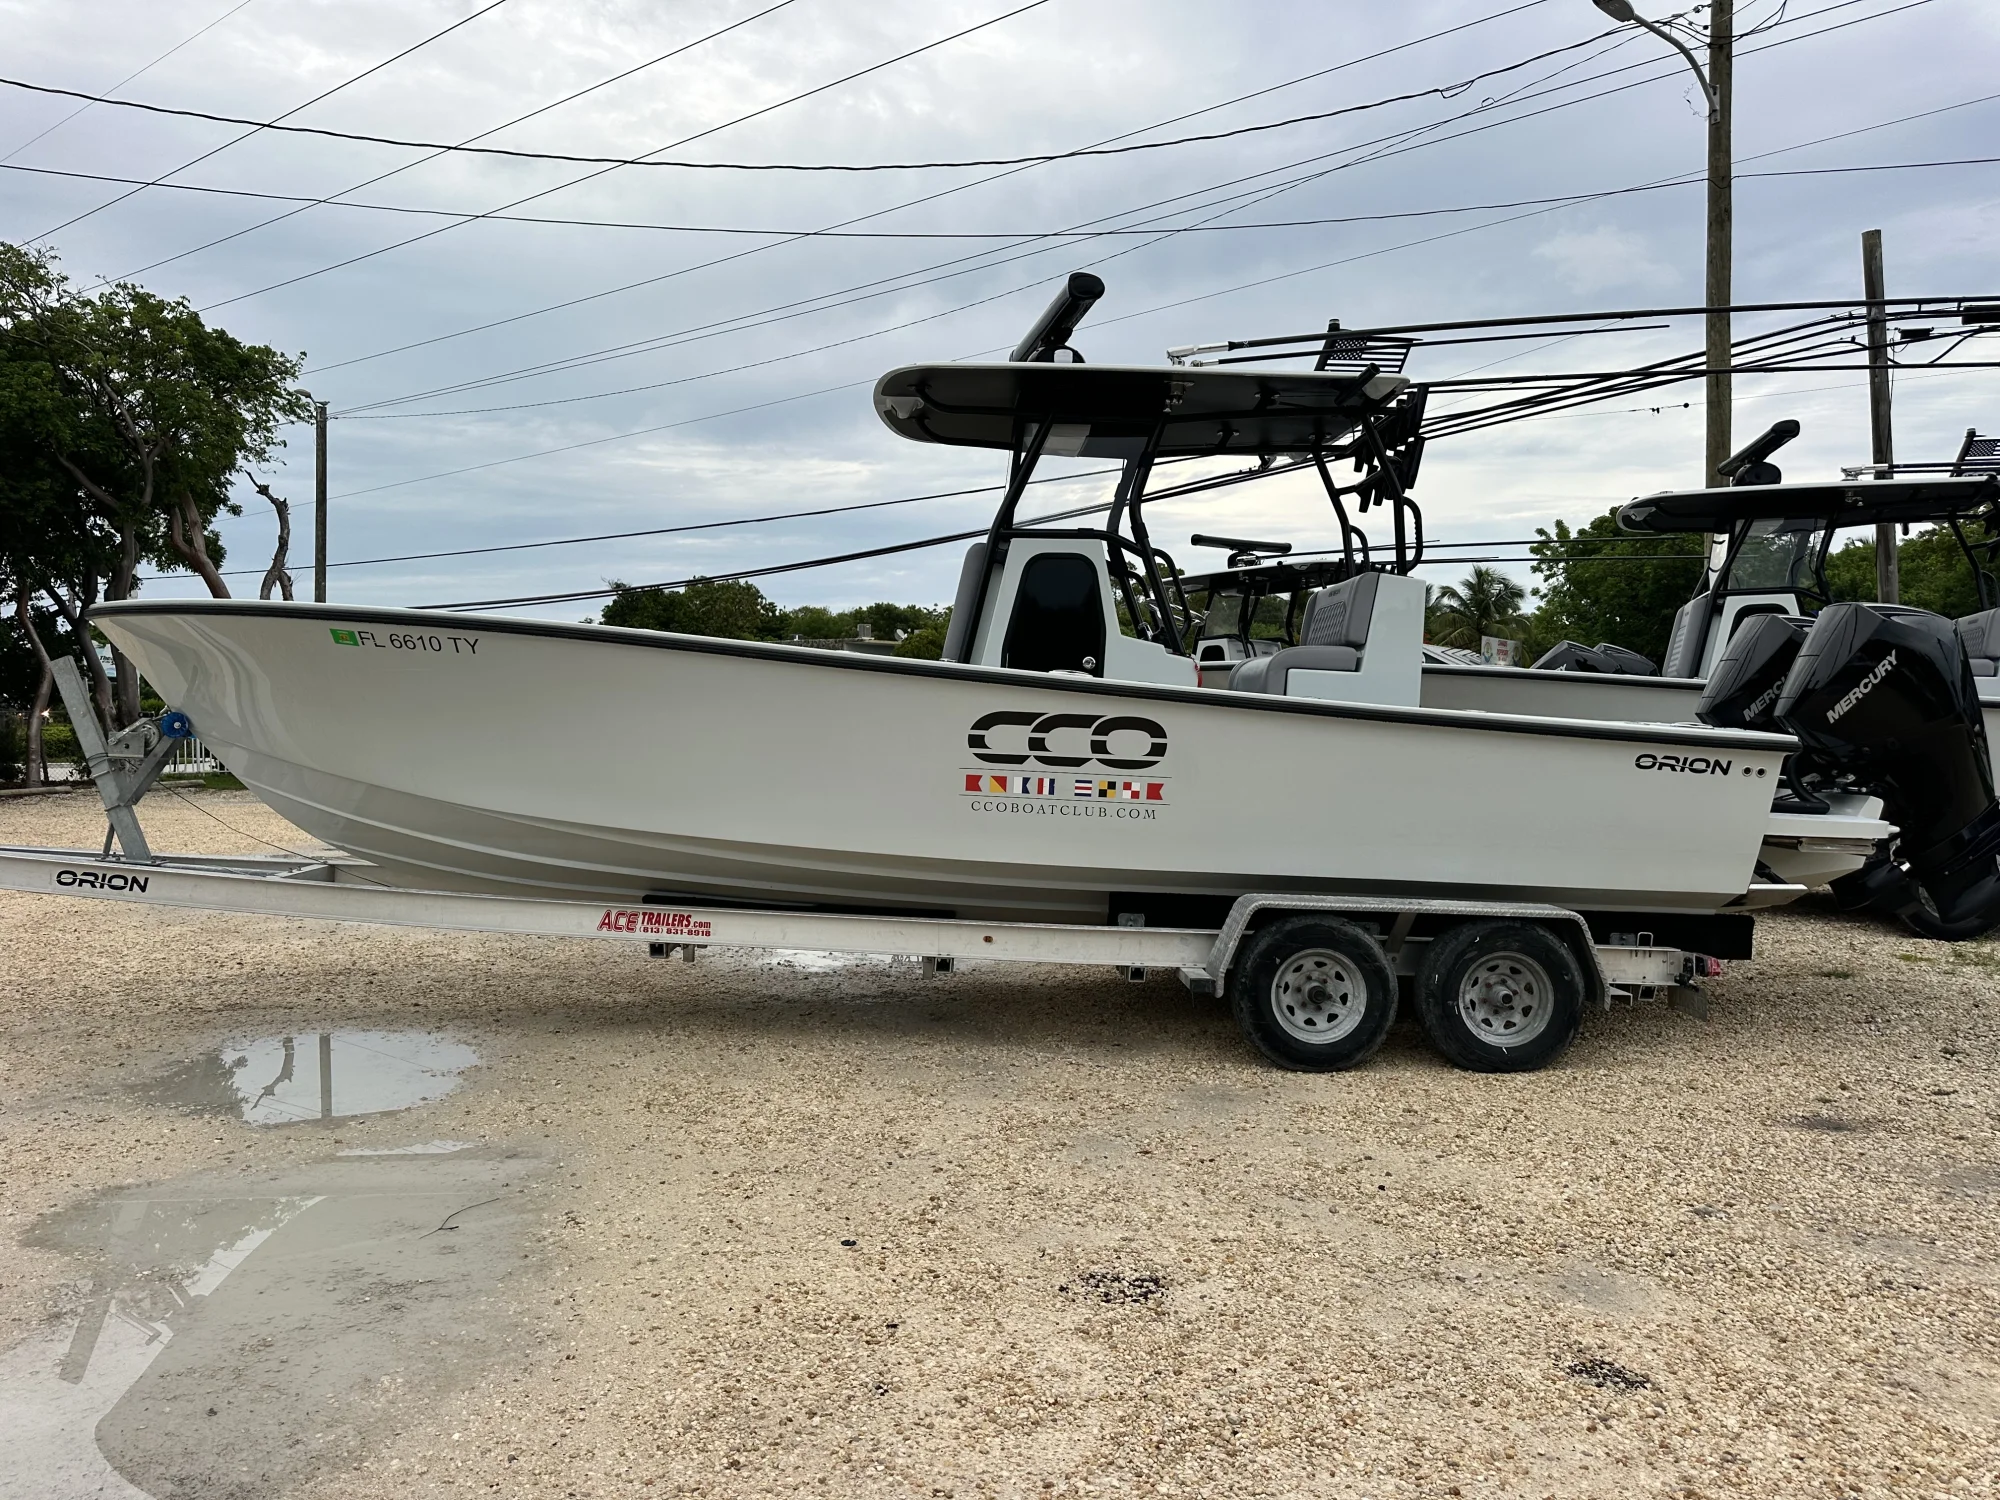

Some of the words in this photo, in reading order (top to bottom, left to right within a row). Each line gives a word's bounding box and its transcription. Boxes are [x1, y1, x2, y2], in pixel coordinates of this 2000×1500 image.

[357, 630, 386, 648] FL
[389, 633, 442, 652] 6610
[447, 636, 479, 655] TY
[1743, 671, 1789, 722] MERC
[1826, 648, 1898, 724] MERCURY
[967, 710, 1168, 770] CCO
[1634, 753, 1733, 776] ORION
[970, 800, 1157, 820] CCOBOATCLUB.COM
[56, 869, 150, 893] ORION
[597, 909, 640, 933] ACE
[641, 911, 711, 929] TRAILERS.com
[640, 926, 664, 934] (813)
[666, 927, 711, 937] 831-8918
